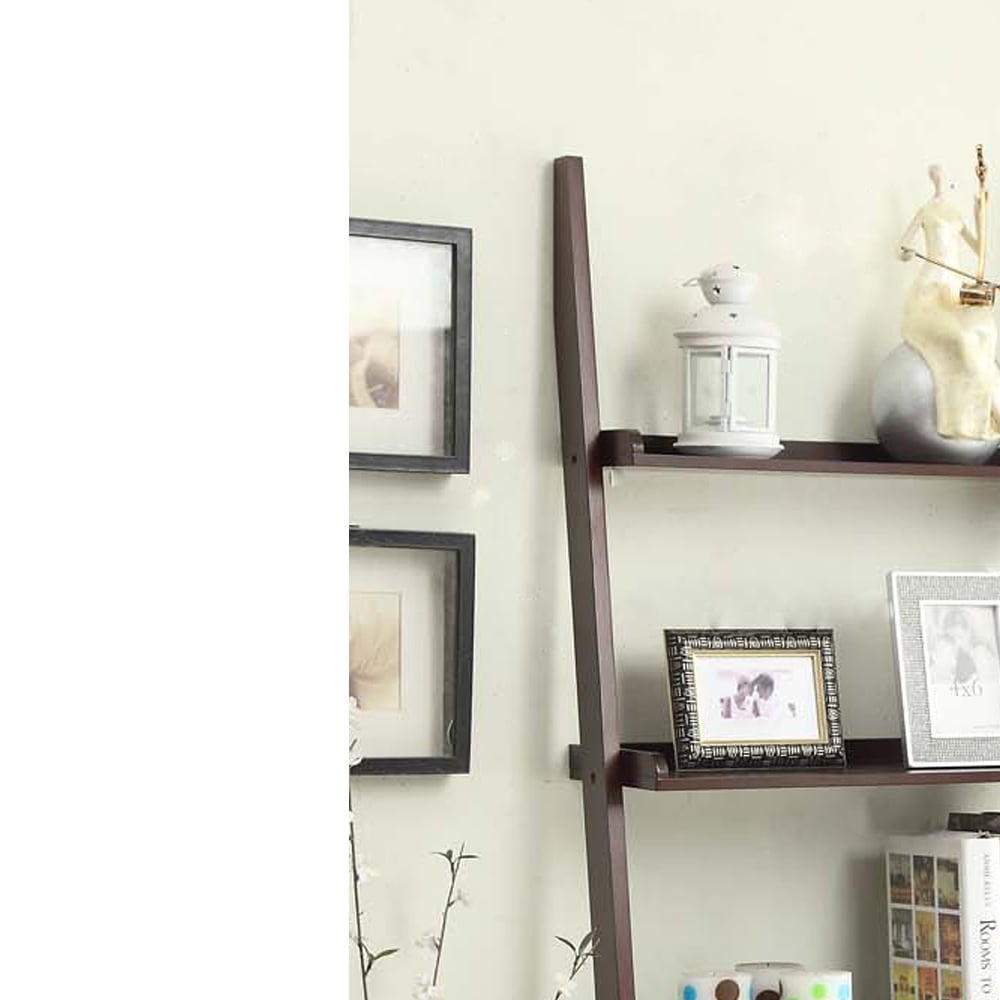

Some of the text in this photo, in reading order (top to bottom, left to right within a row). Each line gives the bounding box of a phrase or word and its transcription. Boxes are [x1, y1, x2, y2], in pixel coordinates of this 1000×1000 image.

[949, 680, 983, 697] 4x6
[979, 919, 997, 971] ROOMS
[979, 977, 991, 994] TO
